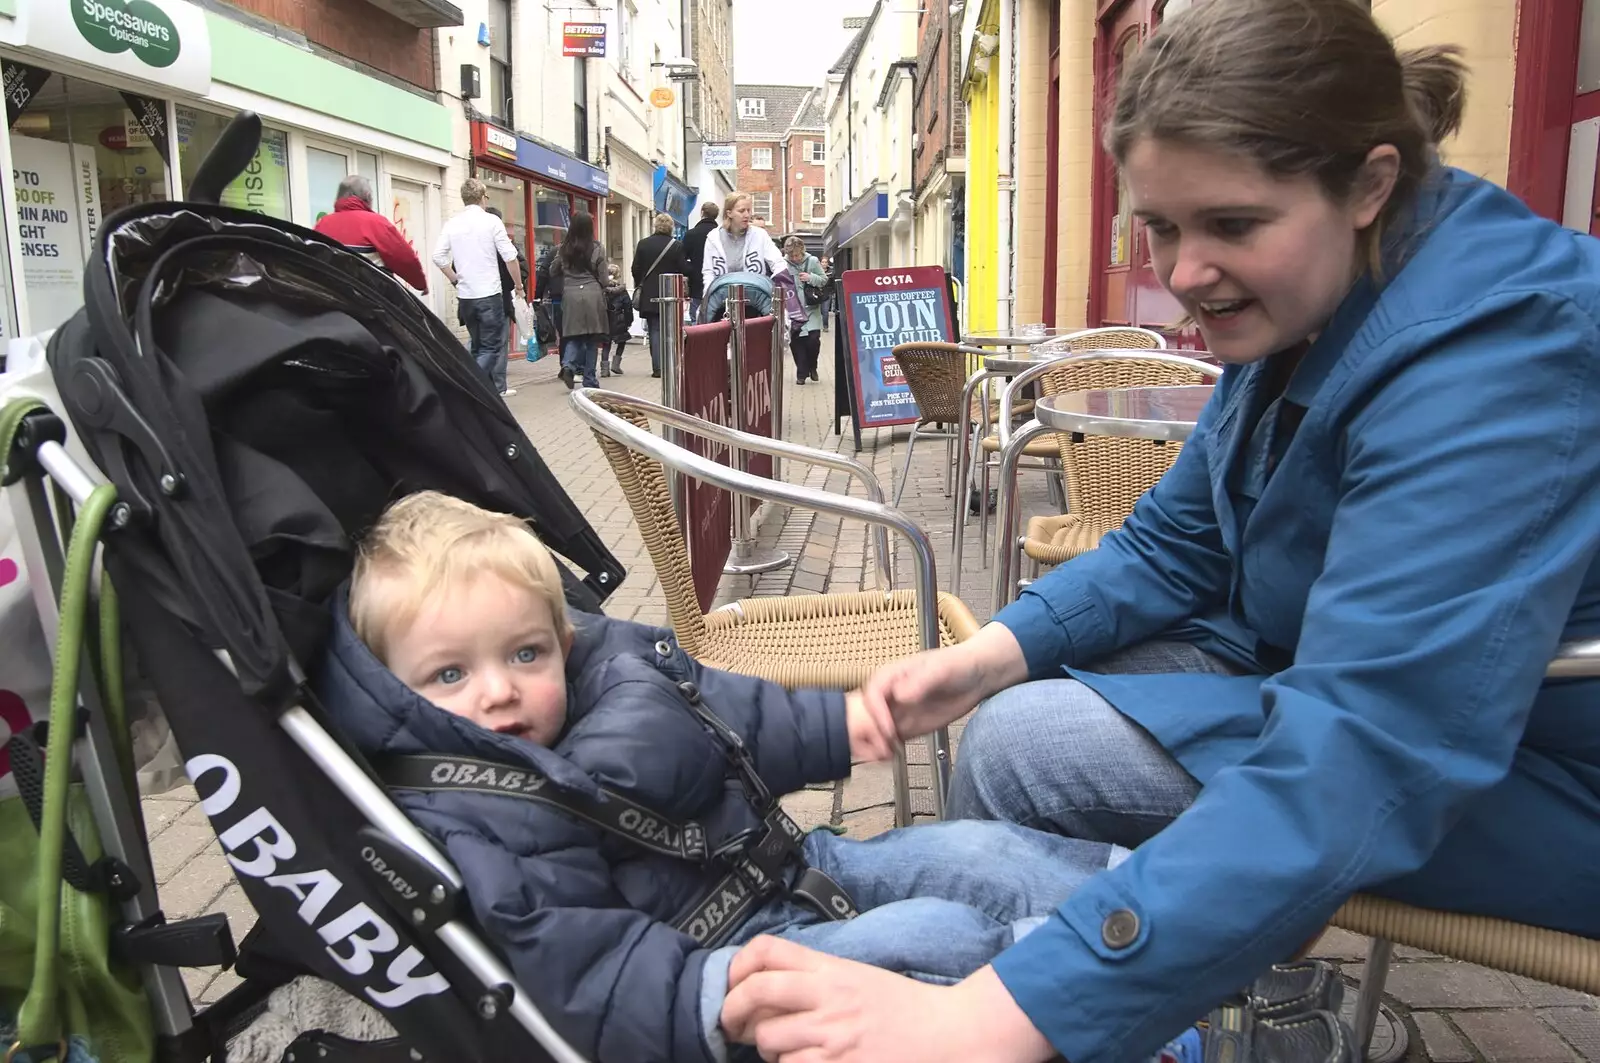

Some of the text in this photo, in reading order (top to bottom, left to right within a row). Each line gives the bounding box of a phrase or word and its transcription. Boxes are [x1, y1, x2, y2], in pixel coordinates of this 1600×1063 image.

[83, 0, 170, 42] Specsavers
[564, 25, 605, 34] BETFRED
[109, 24, 149, 48] Opticians
[588, 47, 604, 55] king
[12, 82, 30, 109] £25
[705, 158, 734, 167] Express
[706, 149, 732, 157] Optical
[22, 171, 40, 187] TO
[82, 160, 94, 205] VALUE
[31, 189, 56, 205] OFF
[41, 208, 69, 224] AND
[745, 251, 762, 275] 5
[874, 274, 914, 286] COSTA
[856, 290, 936, 304] LOVE FREE COFFEE?
[859, 298, 937, 335] JOIN
[861, 329, 945, 350] THE CLUB.
[746, 368, 772, 428] OSTA
[887, 392, 900, 400] PICK
[431, 762, 546, 792] OBABY
[186, 753, 451, 1008] OBABY
[361, 846, 419, 900] OBABY
